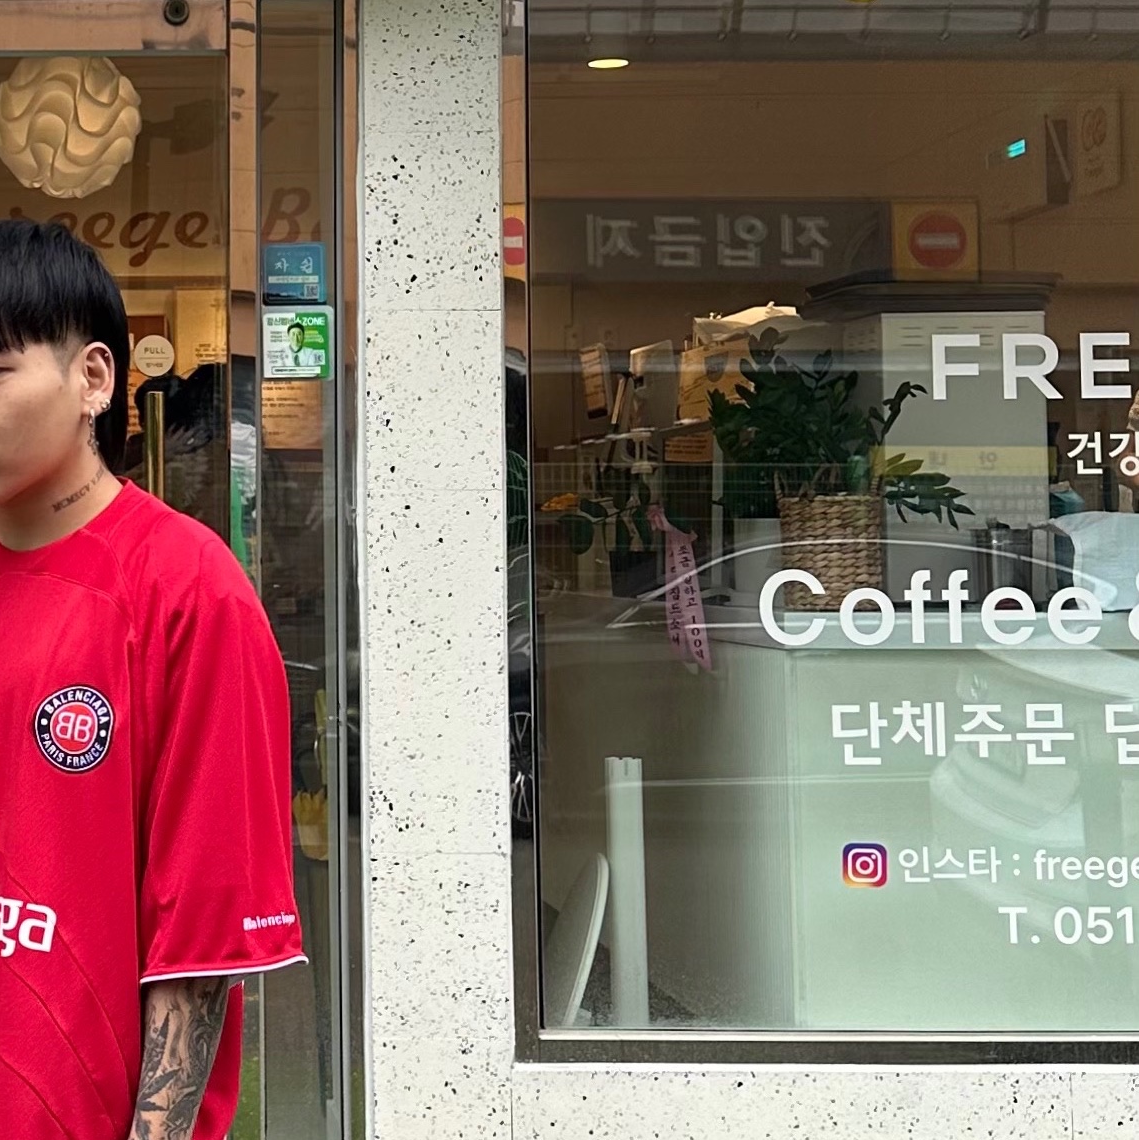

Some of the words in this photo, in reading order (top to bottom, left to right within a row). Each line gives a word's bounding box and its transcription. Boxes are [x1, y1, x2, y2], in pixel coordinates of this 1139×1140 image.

[932, 332, 1132, 400] FRE
[760, 569, 1103, 646] Coffee
[41, 733, 65, 762] PARIS
[66, 742, 104, 767] FRANCE
[831, 700, 1075, 765] 단체주문
[898, 846, 1002, 883] 인스타
[998, 906, 1041, 944] T.
[1053, 906, 1134, 945] 051
